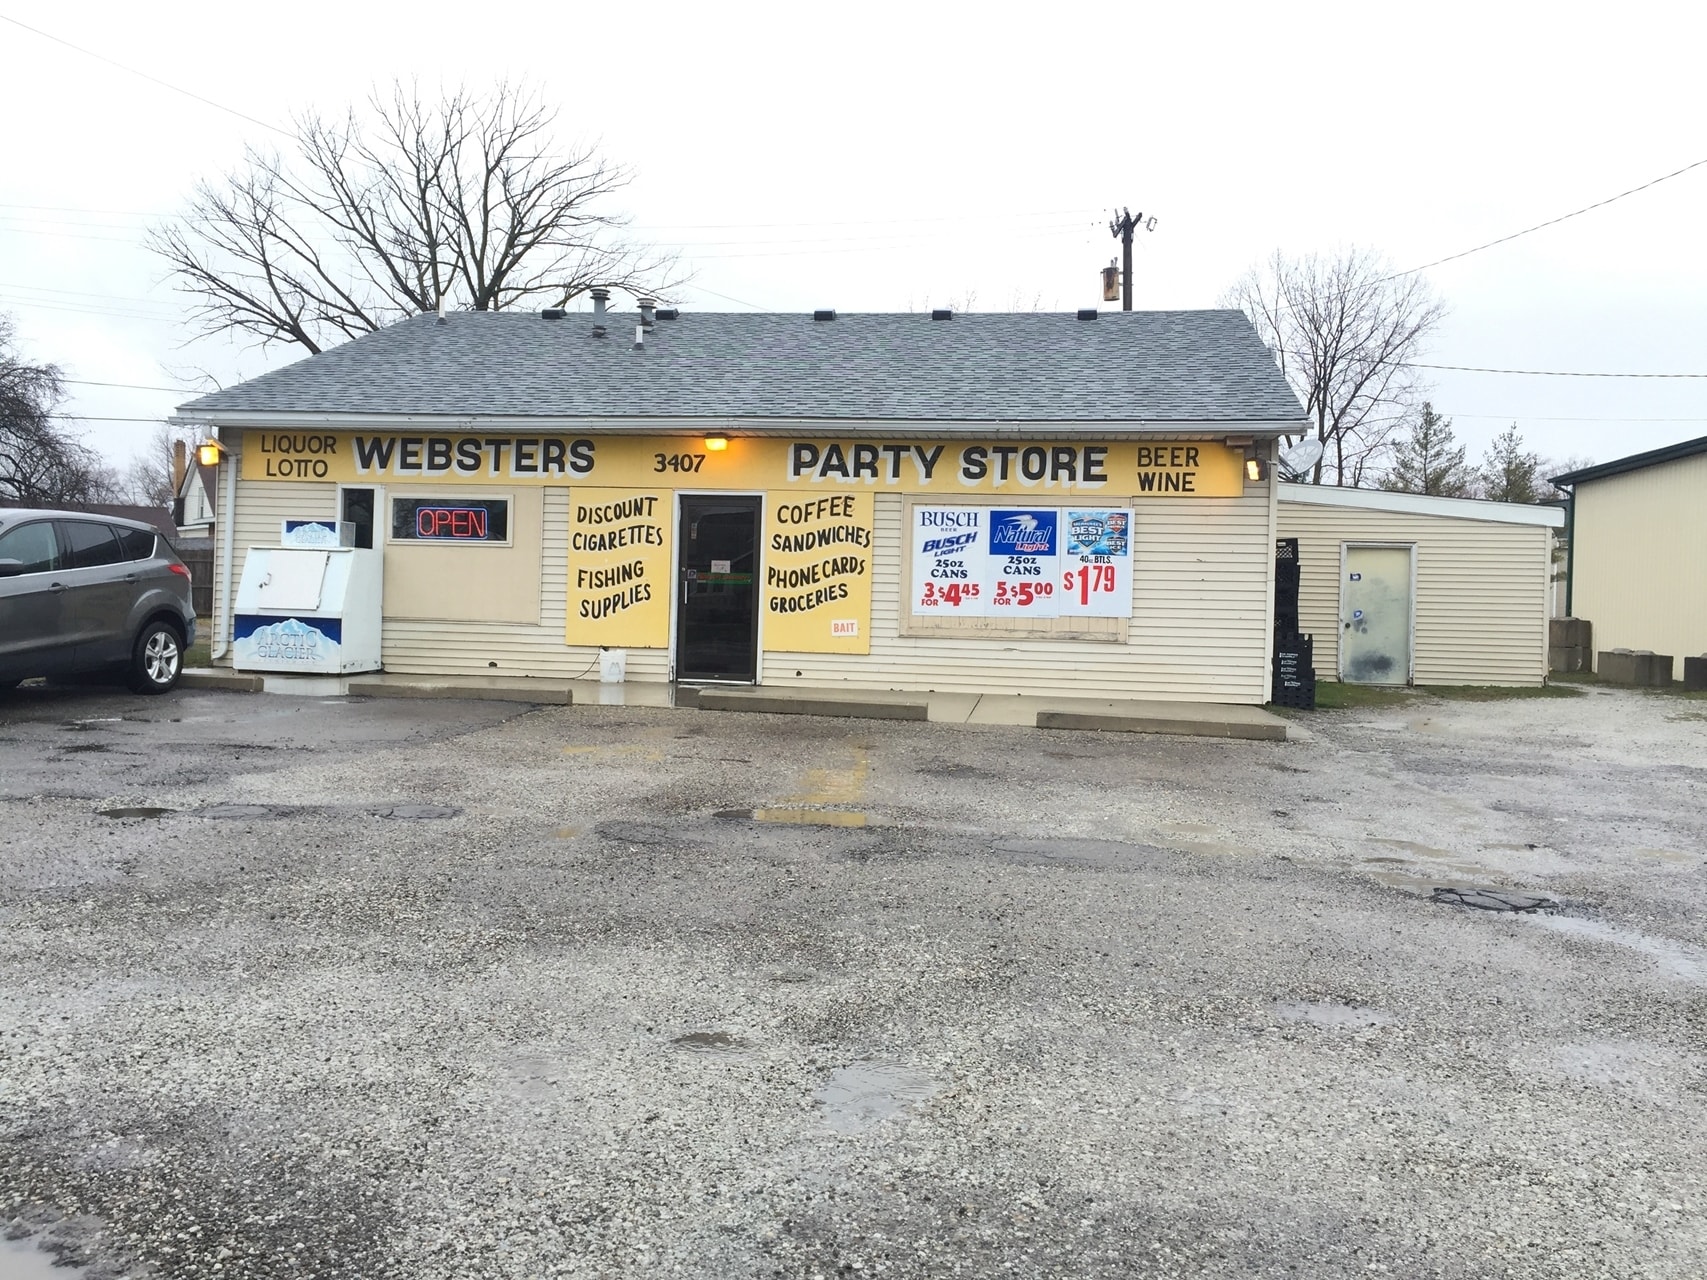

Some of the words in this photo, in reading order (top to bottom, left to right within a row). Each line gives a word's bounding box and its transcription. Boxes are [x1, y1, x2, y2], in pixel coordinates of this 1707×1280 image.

[260, 434, 337, 454] LIQUOR
[353, 436, 596, 476] WEBSTERS
[653, 453, 706, 473] 3407
[788, 442, 945, 483] PARTY
[959, 445, 1108, 486] STORE
[1137, 446, 1199, 468] BEER
[266, 458, 328, 478] LOTTO
[1137, 471, 1196, 492] WINE
[577, 497, 658, 524] DISCOUNT
[777, 496, 855, 525] COFFEE
[920, 511, 980, 527] BUSCH
[419, 510, 486, 537] OPEN
[1071, 526, 1103, 535] BEST
[572, 525, 663, 551] CIGARETTES
[771, 525, 871, 552] SANDWICHES
[922, 531, 978, 553] BUSCH
[994, 525, 1053, 543] Natural
[934, 545, 966, 557] LIGHT
[1015, 542, 1050, 552] Light
[577, 560, 644, 589] FISHING
[768, 563, 820, 588] PHONE
[822, 556, 866, 579] CARDS
[930, 569, 968, 579] CANS
[1003, 566, 1041, 576] CANS
[769, 583, 848, 613] GROCERIES
[924, 582, 935, 598] 3
[996, 581, 1007, 597] 5
[579, 583, 651, 619] SUPPLIES
[921, 598, 939, 606] FOR
[993, 597, 1011, 605] FOR
[833, 622, 855, 633] BAIT
[257, 629, 317, 647] ARCTIC
[257, 645, 316, 660] GLACIER
